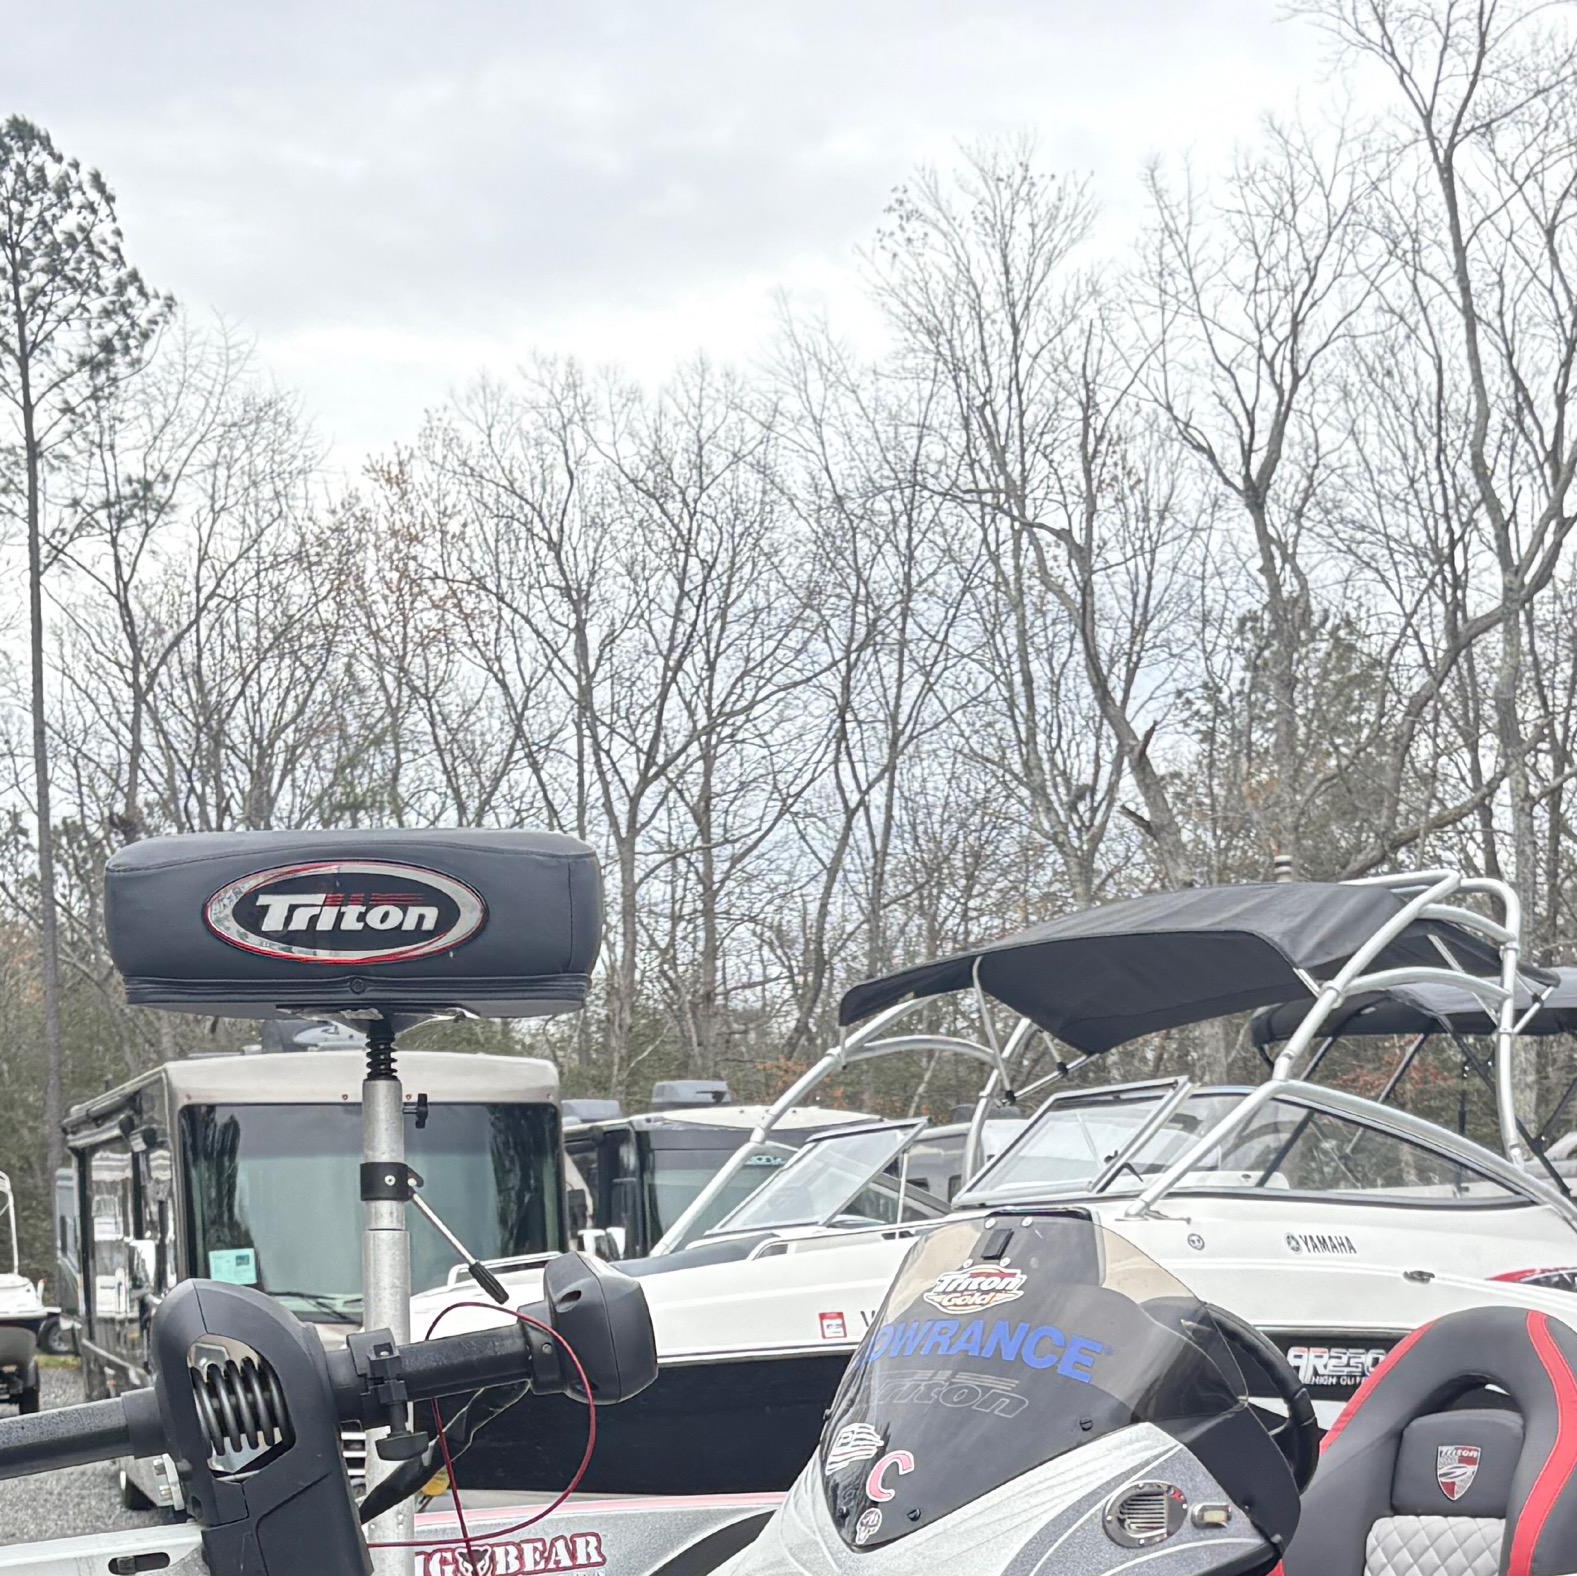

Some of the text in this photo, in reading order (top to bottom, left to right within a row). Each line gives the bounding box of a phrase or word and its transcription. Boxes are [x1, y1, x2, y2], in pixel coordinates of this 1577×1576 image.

[256, 891, 440, 932] Triton
[1298, 1234, 1358, 1254] YAMAHA
[932, 1274, 1023, 1292] Triton
[941, 1292, 997, 1306] Gold
[856, 1318, 1105, 1375] OWRANCE
